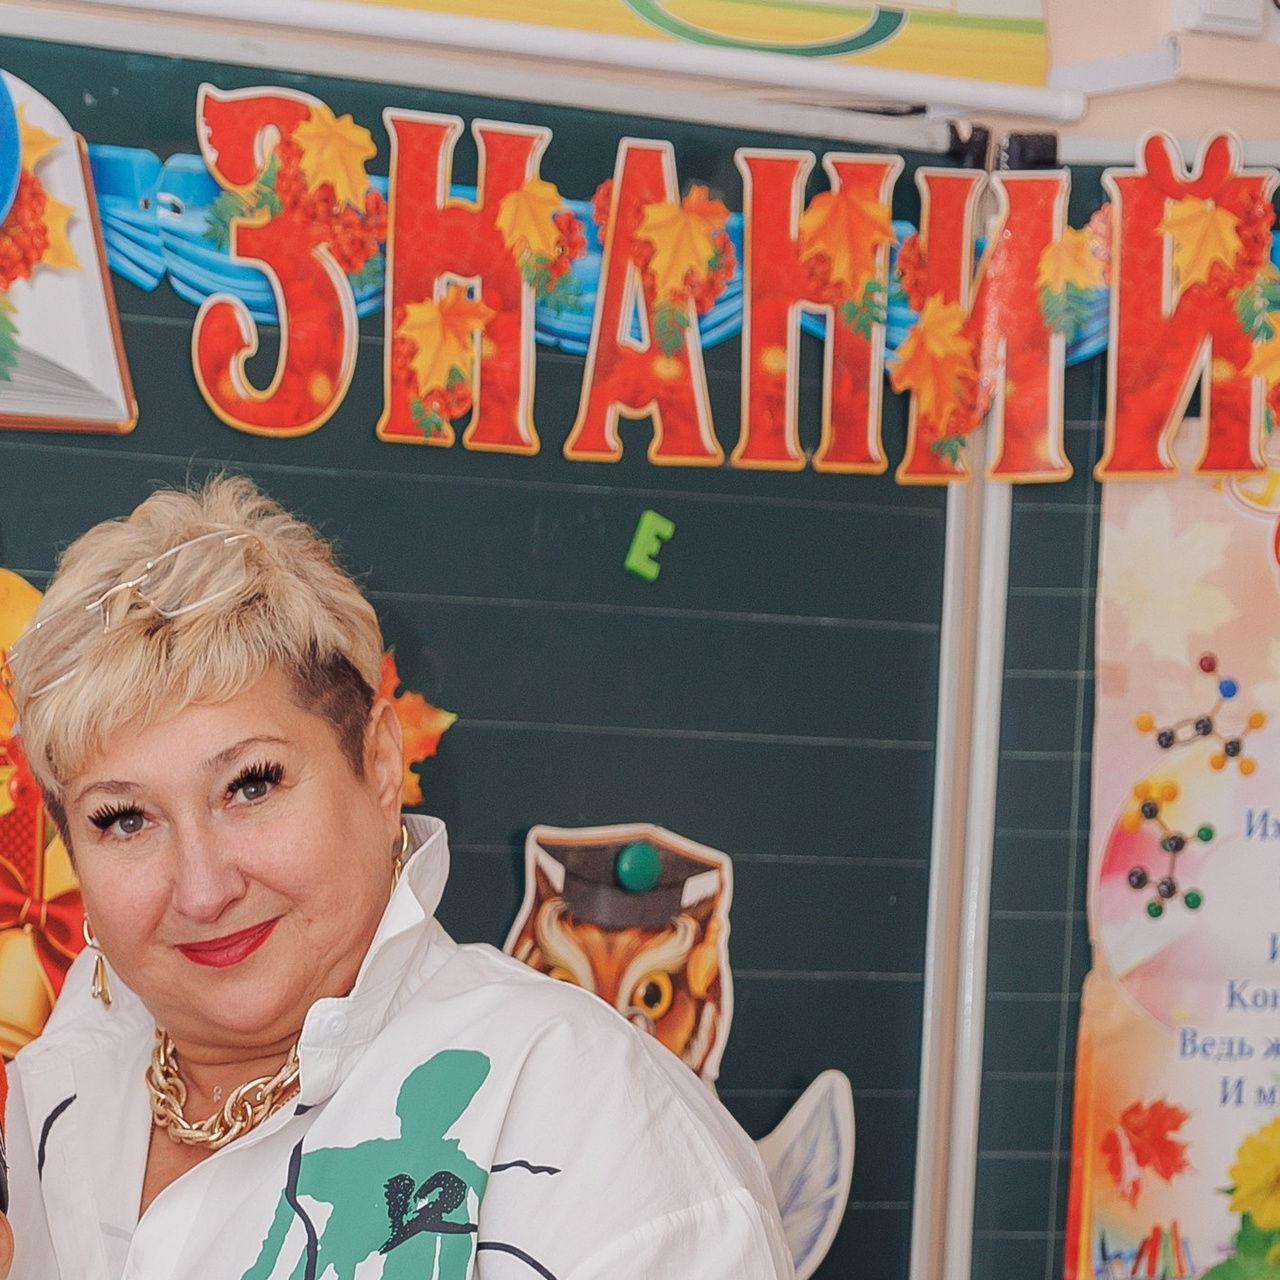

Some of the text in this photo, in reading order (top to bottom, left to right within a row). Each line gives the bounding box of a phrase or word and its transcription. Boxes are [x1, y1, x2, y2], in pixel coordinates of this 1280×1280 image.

[195, 83, 1280, 485] ЗНАНИЙ
[624, 508, 675, 583] Е
[1180, 1027, 1255, 1062] Ведь
